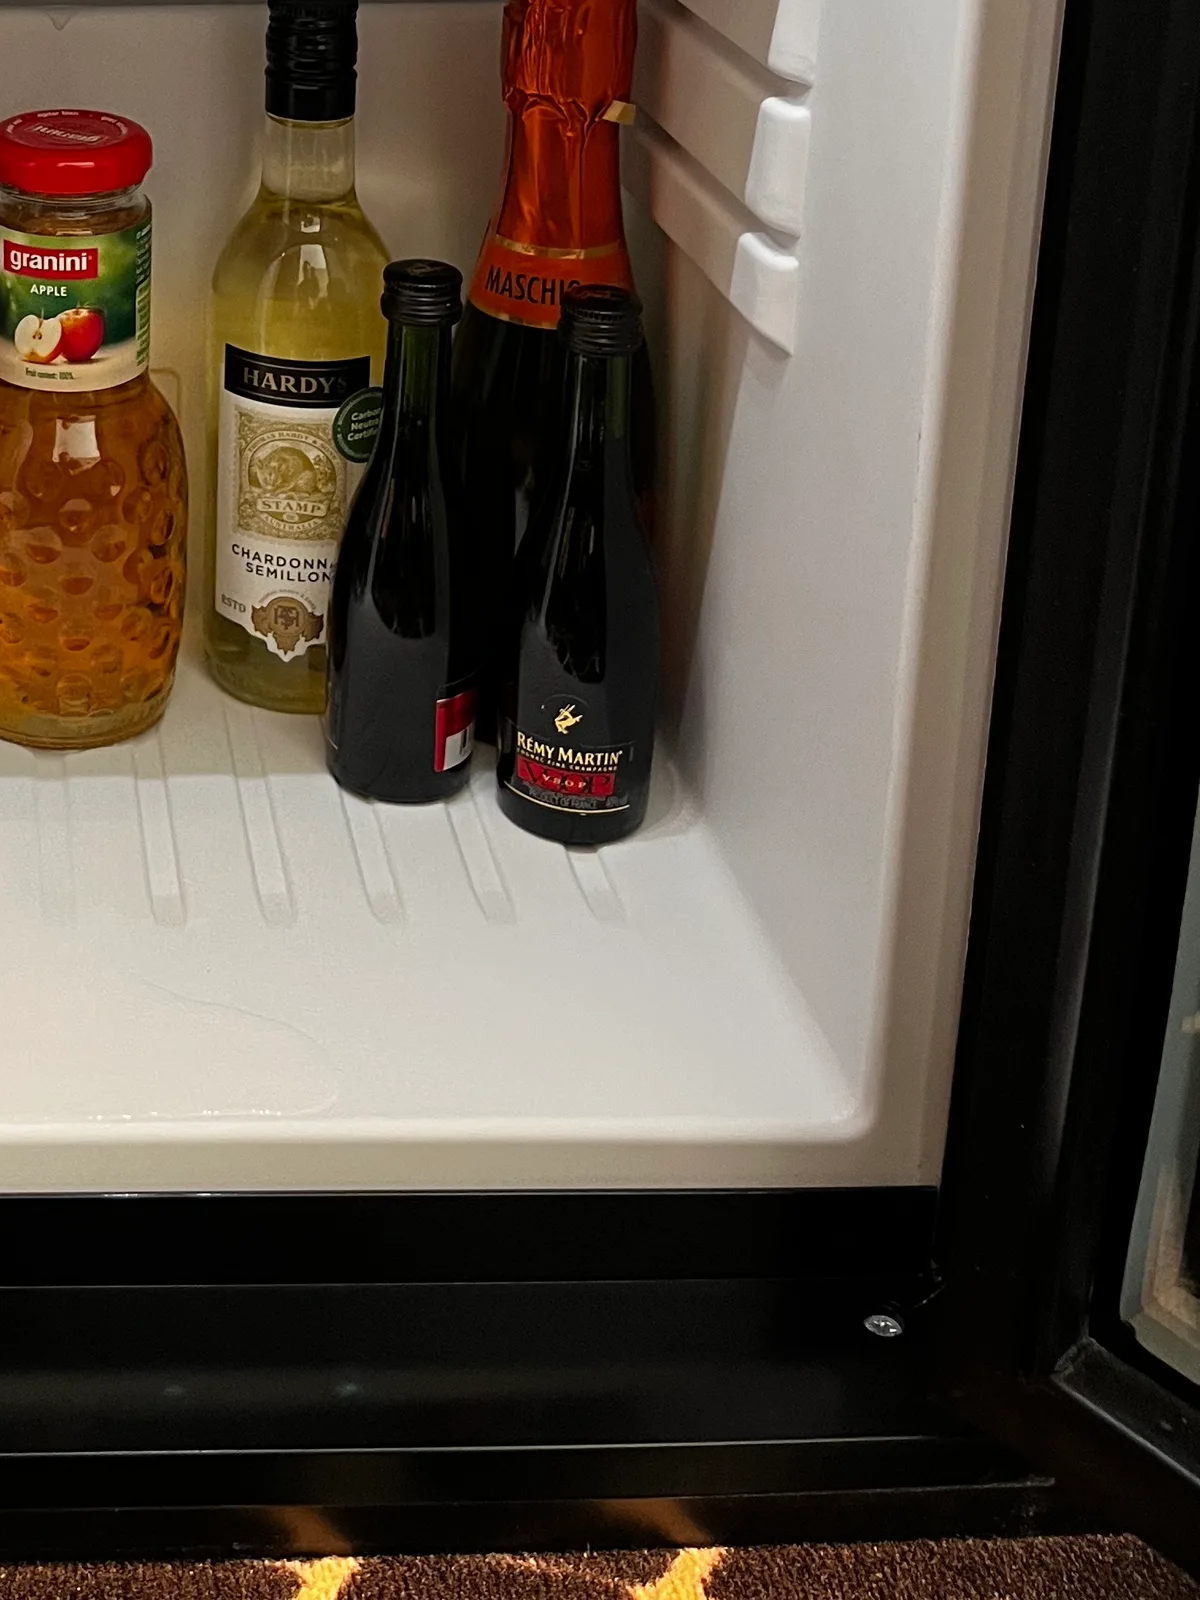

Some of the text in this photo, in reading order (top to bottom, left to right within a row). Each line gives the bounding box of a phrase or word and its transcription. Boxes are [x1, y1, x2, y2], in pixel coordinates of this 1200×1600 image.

[9, 249, 89, 272] granini
[30, 284, 68, 297] APPLE
[260, 499, 322, 514] STAMP
[231, 544, 337, 570] CHARDONN
[517, 731, 620, 767] RÉMY MARTIN
